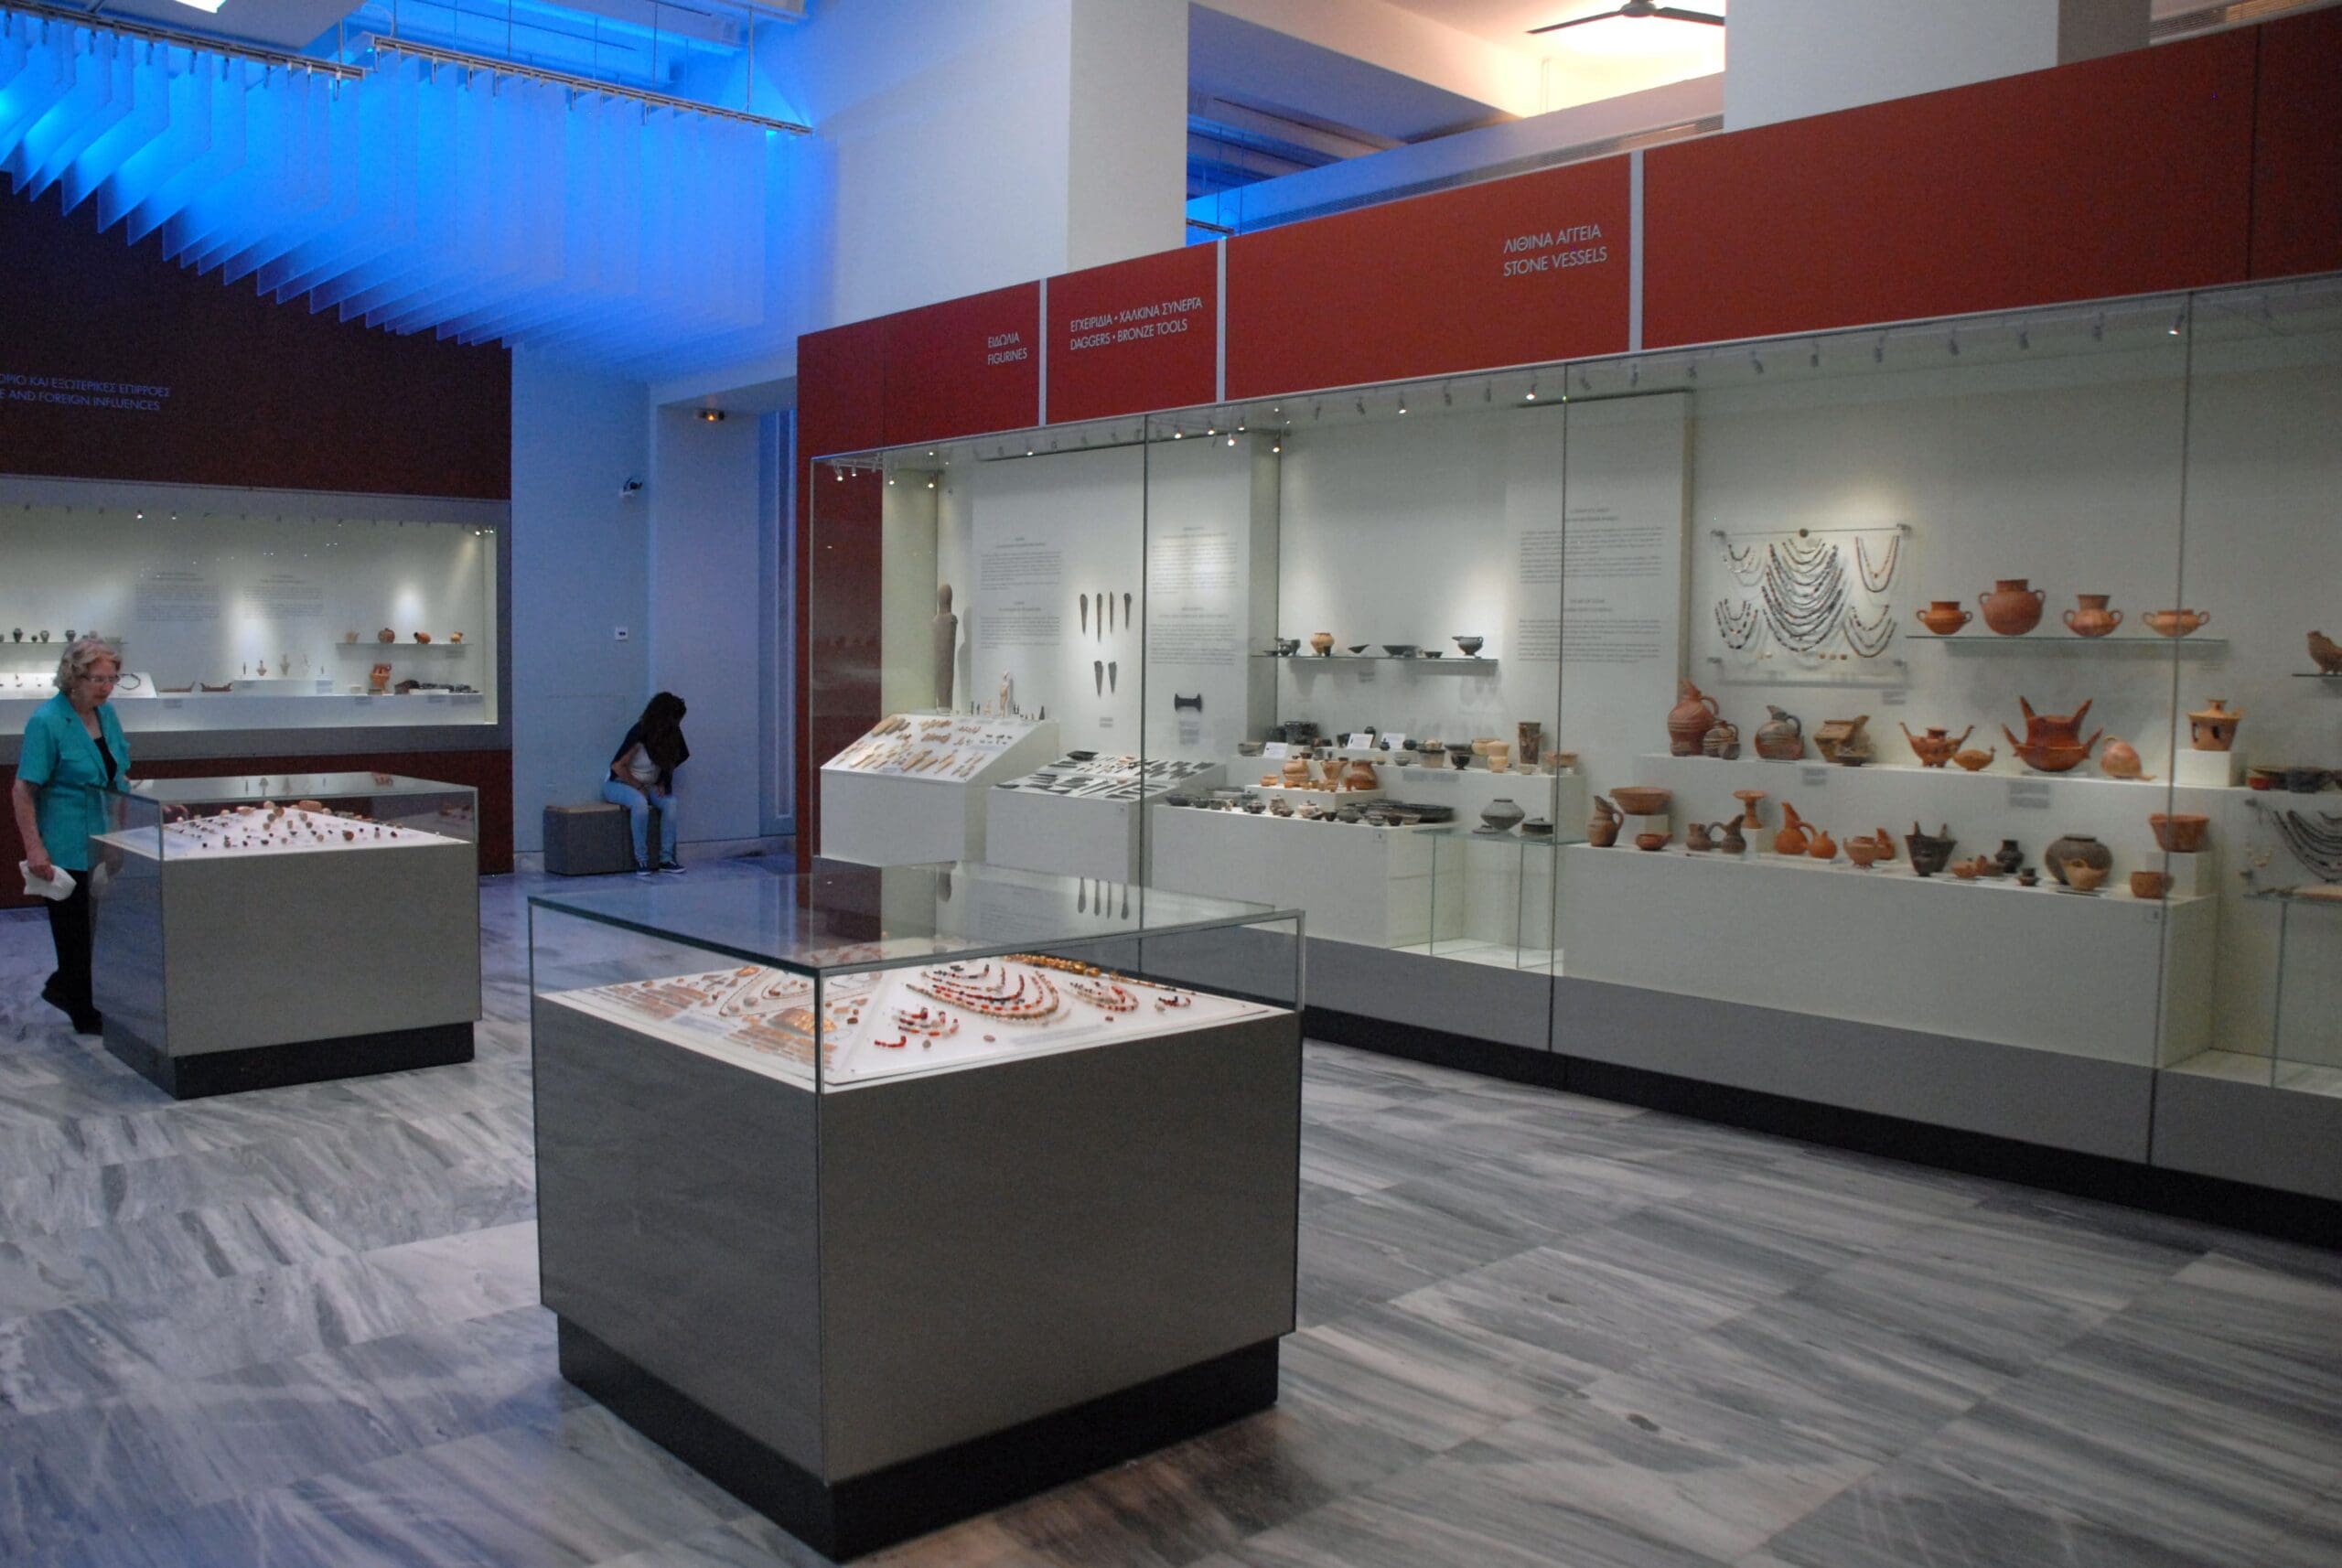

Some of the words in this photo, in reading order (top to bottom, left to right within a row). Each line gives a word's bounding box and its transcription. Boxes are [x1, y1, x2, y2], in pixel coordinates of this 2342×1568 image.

[1503, 231, 1553, 254] ΛΙΘΙΝΑ
[1556, 224, 1602, 245] ΑΓΓΕΙΑ
[1503, 255, 1549, 276] STONE
[1552, 246, 1607, 268] VESSELS
[1119, 305, 1160, 323] ΧΑΛΚΙΝΑ
[1162, 297, 1203, 316] ΣΥΝΕΡΓΑ
[1070, 332, 1111, 350] DAGGERS
[1117, 324, 1155, 342] BRONZE
[1156, 318, 1188, 336] TOOLS
[988, 348, 1027, 365] FIGURINES
[8, 390, 36, 402] AND
[39, 392, 90, 406] FOREIGN
[93, 397, 160, 411] INFLUENCES
